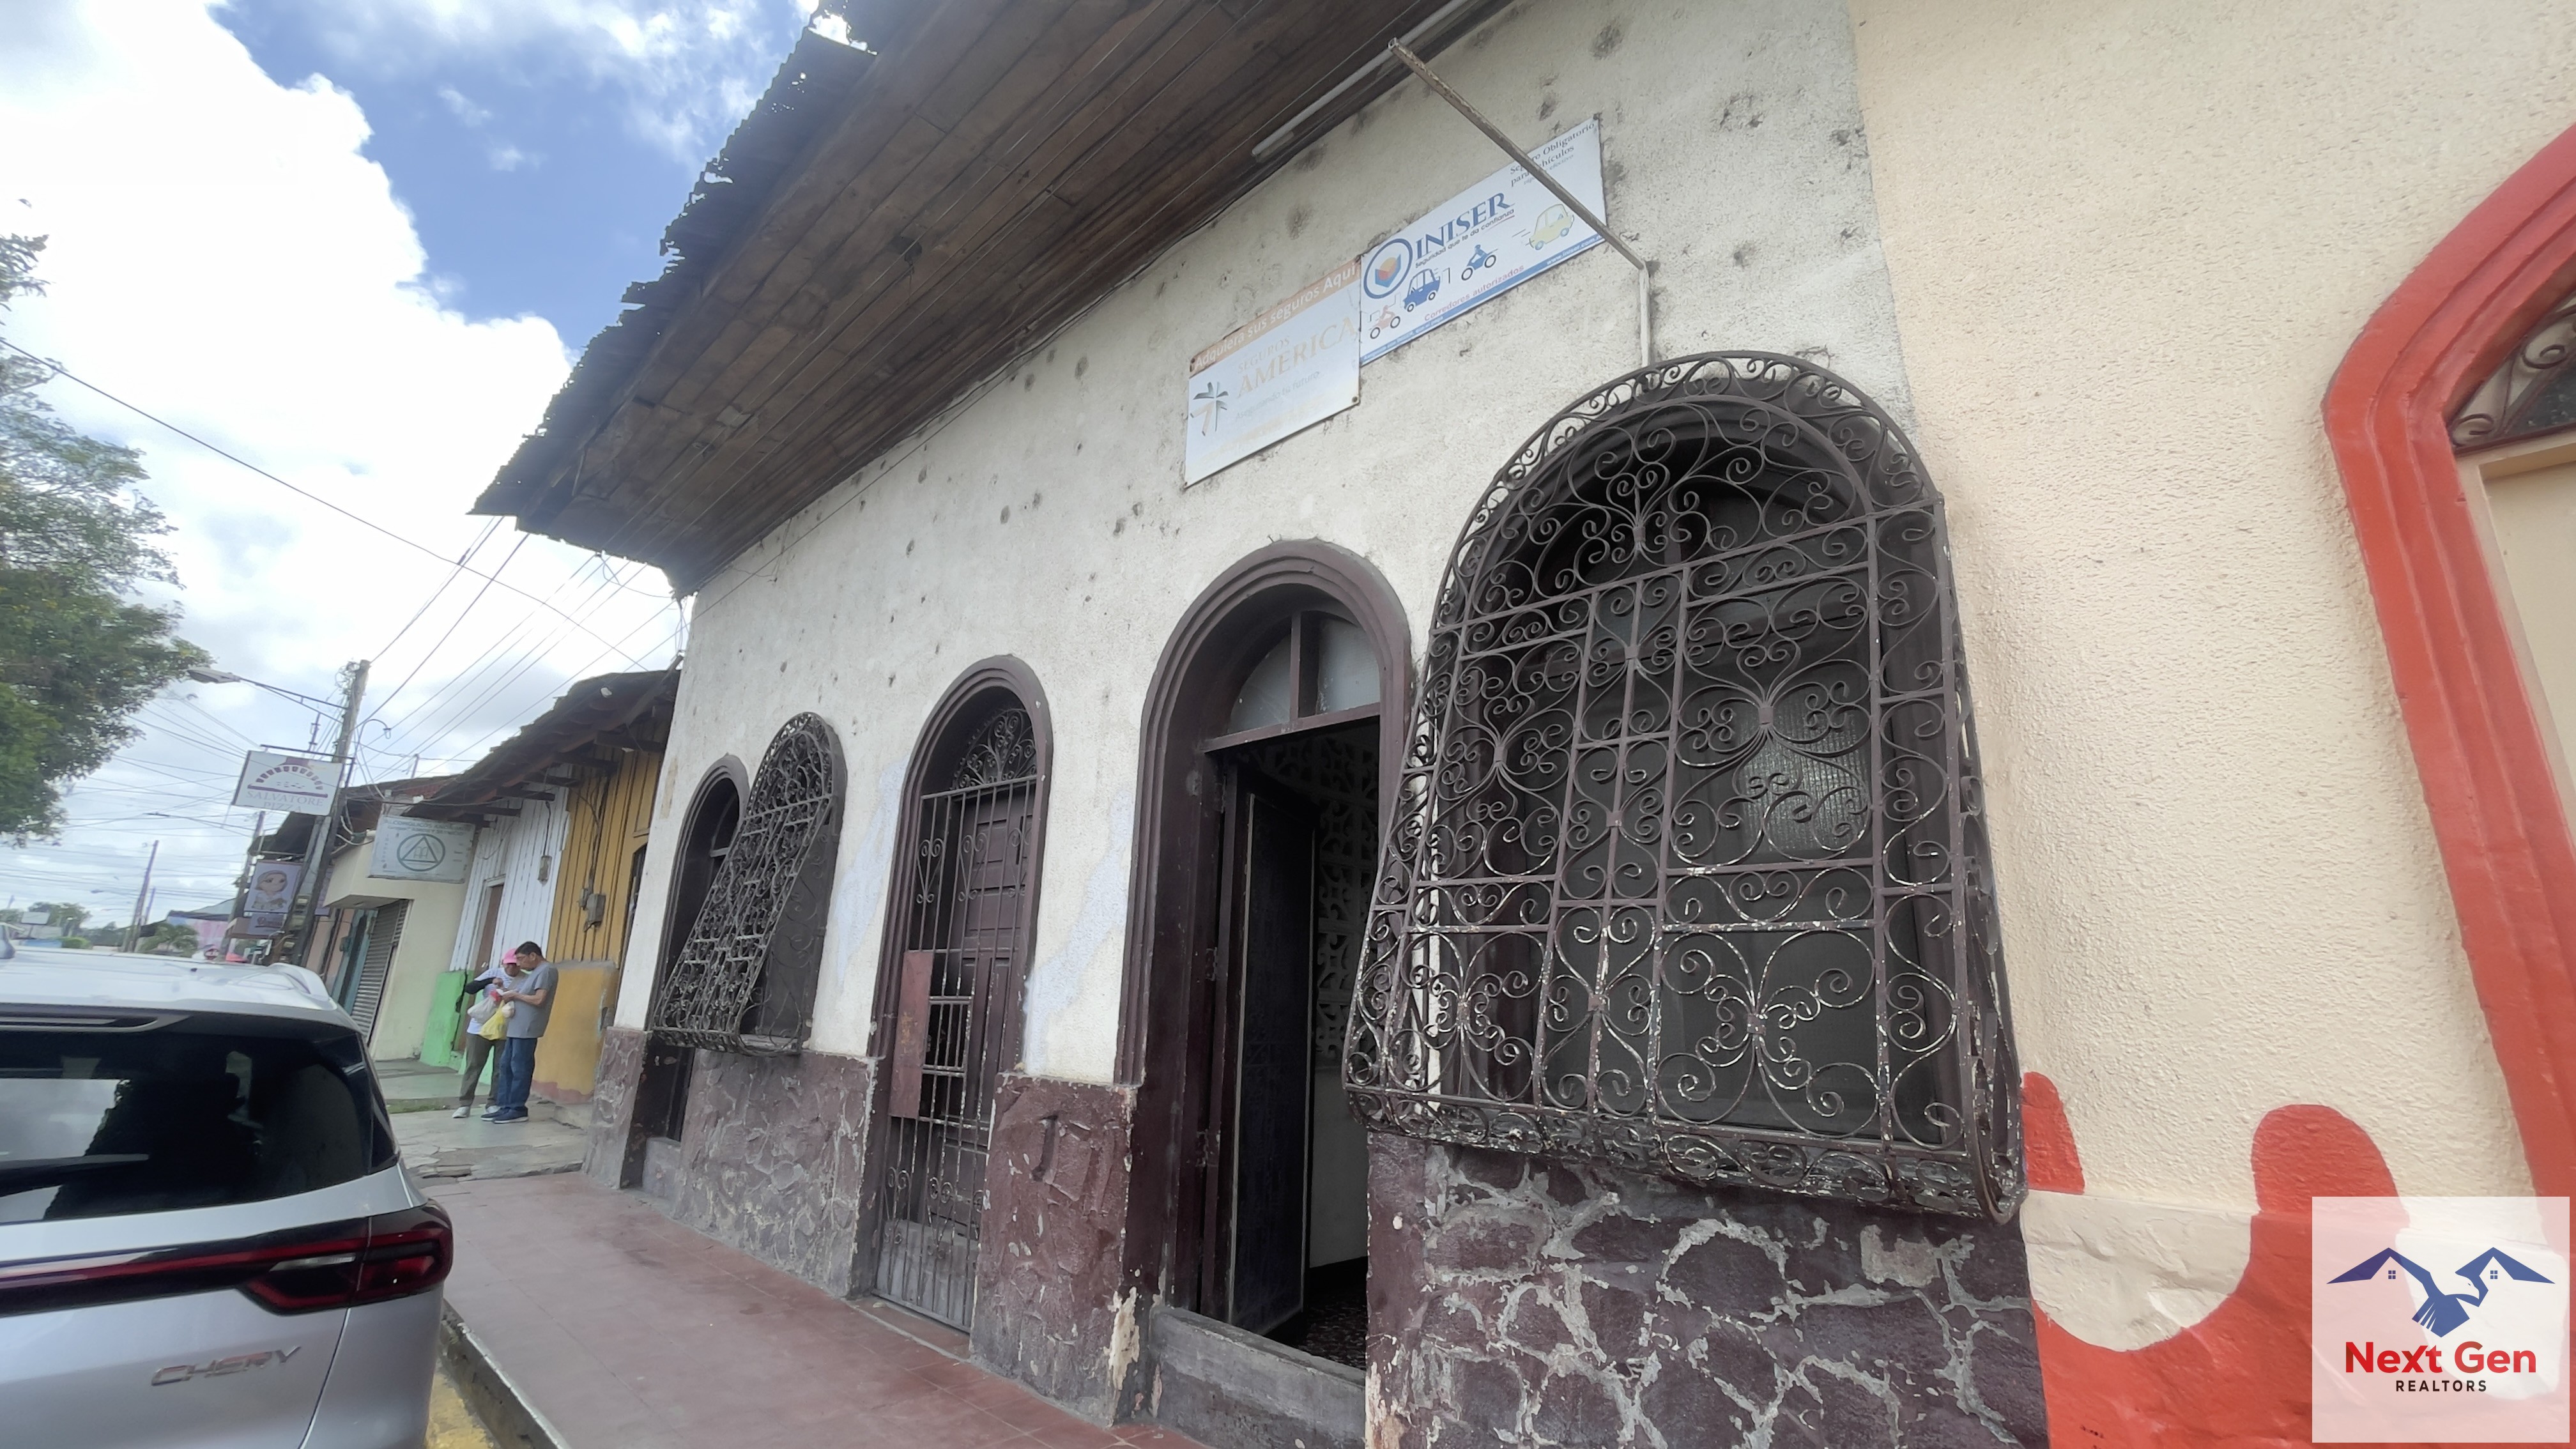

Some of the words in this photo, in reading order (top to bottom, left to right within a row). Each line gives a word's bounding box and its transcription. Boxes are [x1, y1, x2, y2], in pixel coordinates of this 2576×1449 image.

[1510, 153, 1540, 175] Sero
[1543, 123, 1595, 155] Obligatorio
[1536, 146, 1574, 168] hículos
[1415, 246, 1446, 268] Seguridad
[1448, 240, 1460, 250] que
[1462, 233, 1469, 241] te
[1470, 227, 1479, 237] da
[1481, 209, 1515, 230] confianza
[1416, 192, 1515, 260] INISER
[1425, 294, 1470, 321] Corredores
[1473, 264, 1524, 296] autorizados
[1195, 330, 1245, 370] Adquiera
[1248, 317, 1267, 337] sus
[1270, 286, 1319, 321] seguros
[1238, 337, 1290, 372] SEGUROS
[246, 790, 324, 807] SALVATORE
[264, 801, 302, 813] PIZZA
[151, 1346, 302, 1386] CHERY
